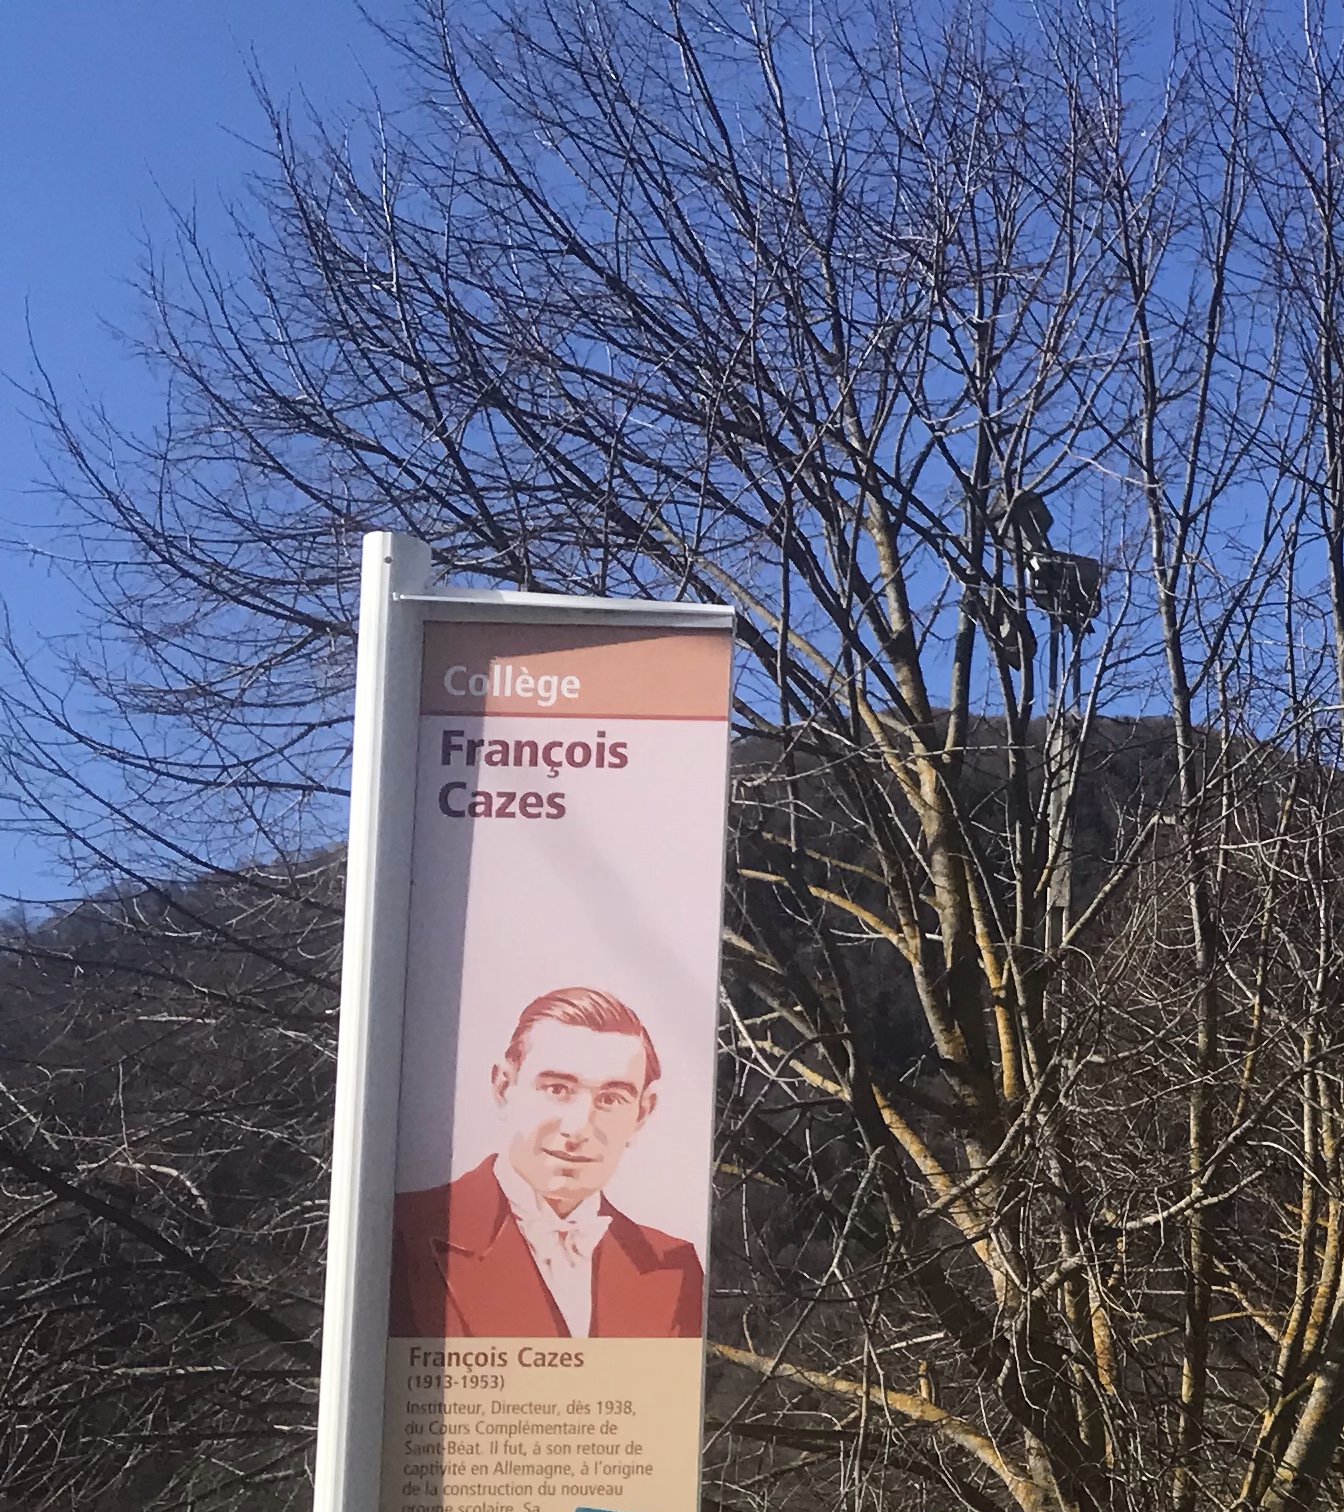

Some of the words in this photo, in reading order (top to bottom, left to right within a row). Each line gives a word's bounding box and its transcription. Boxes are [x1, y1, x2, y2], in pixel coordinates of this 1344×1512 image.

[443, 664, 581, 707] Collège
[440, 729, 629, 779] François
[438, 781, 567, 820] Cazes
[409, 1345, 508, 1373] François
[517, 1346, 585, 1368] Cazes
[407, 1374, 505, 1392] (1913-1953)
[406, 1400, 485, 1417] Instituteur,
[491, 1400, 561, 1417] Directeur,
[566, 1400, 591, 1415] dès
[596, 1400, 636, 1417] 1938,
[404, 1421, 424, 1435] du
[428, 1420, 471, 1436] Cours
[475, 1420, 596, 1438] Complémentaire
[599, 1420, 618, 1435] de
[503, 1440, 527, 1457] fut,
[532, 1440, 542, 1455] à
[546, 1444, 572, 1455] son
[576, 1442, 621, 1455] retour
[624, 1440, 643, 1455] de
[403, 1461, 466, 1479] captivité
[470, 1464, 489, 1476] en
[493, 1461, 575, 1479] Allemagne,
[580, 1461, 590, 1476] à
[594, 1460, 654, 1479] l'origine
[402, 1481, 421, 1496] de
[425, 1481, 438, 1496] la
[443, 1481, 533, 1496] construction
[538, 1481, 556, 1496] du
[561, 1485, 624, 1496] nouveau
